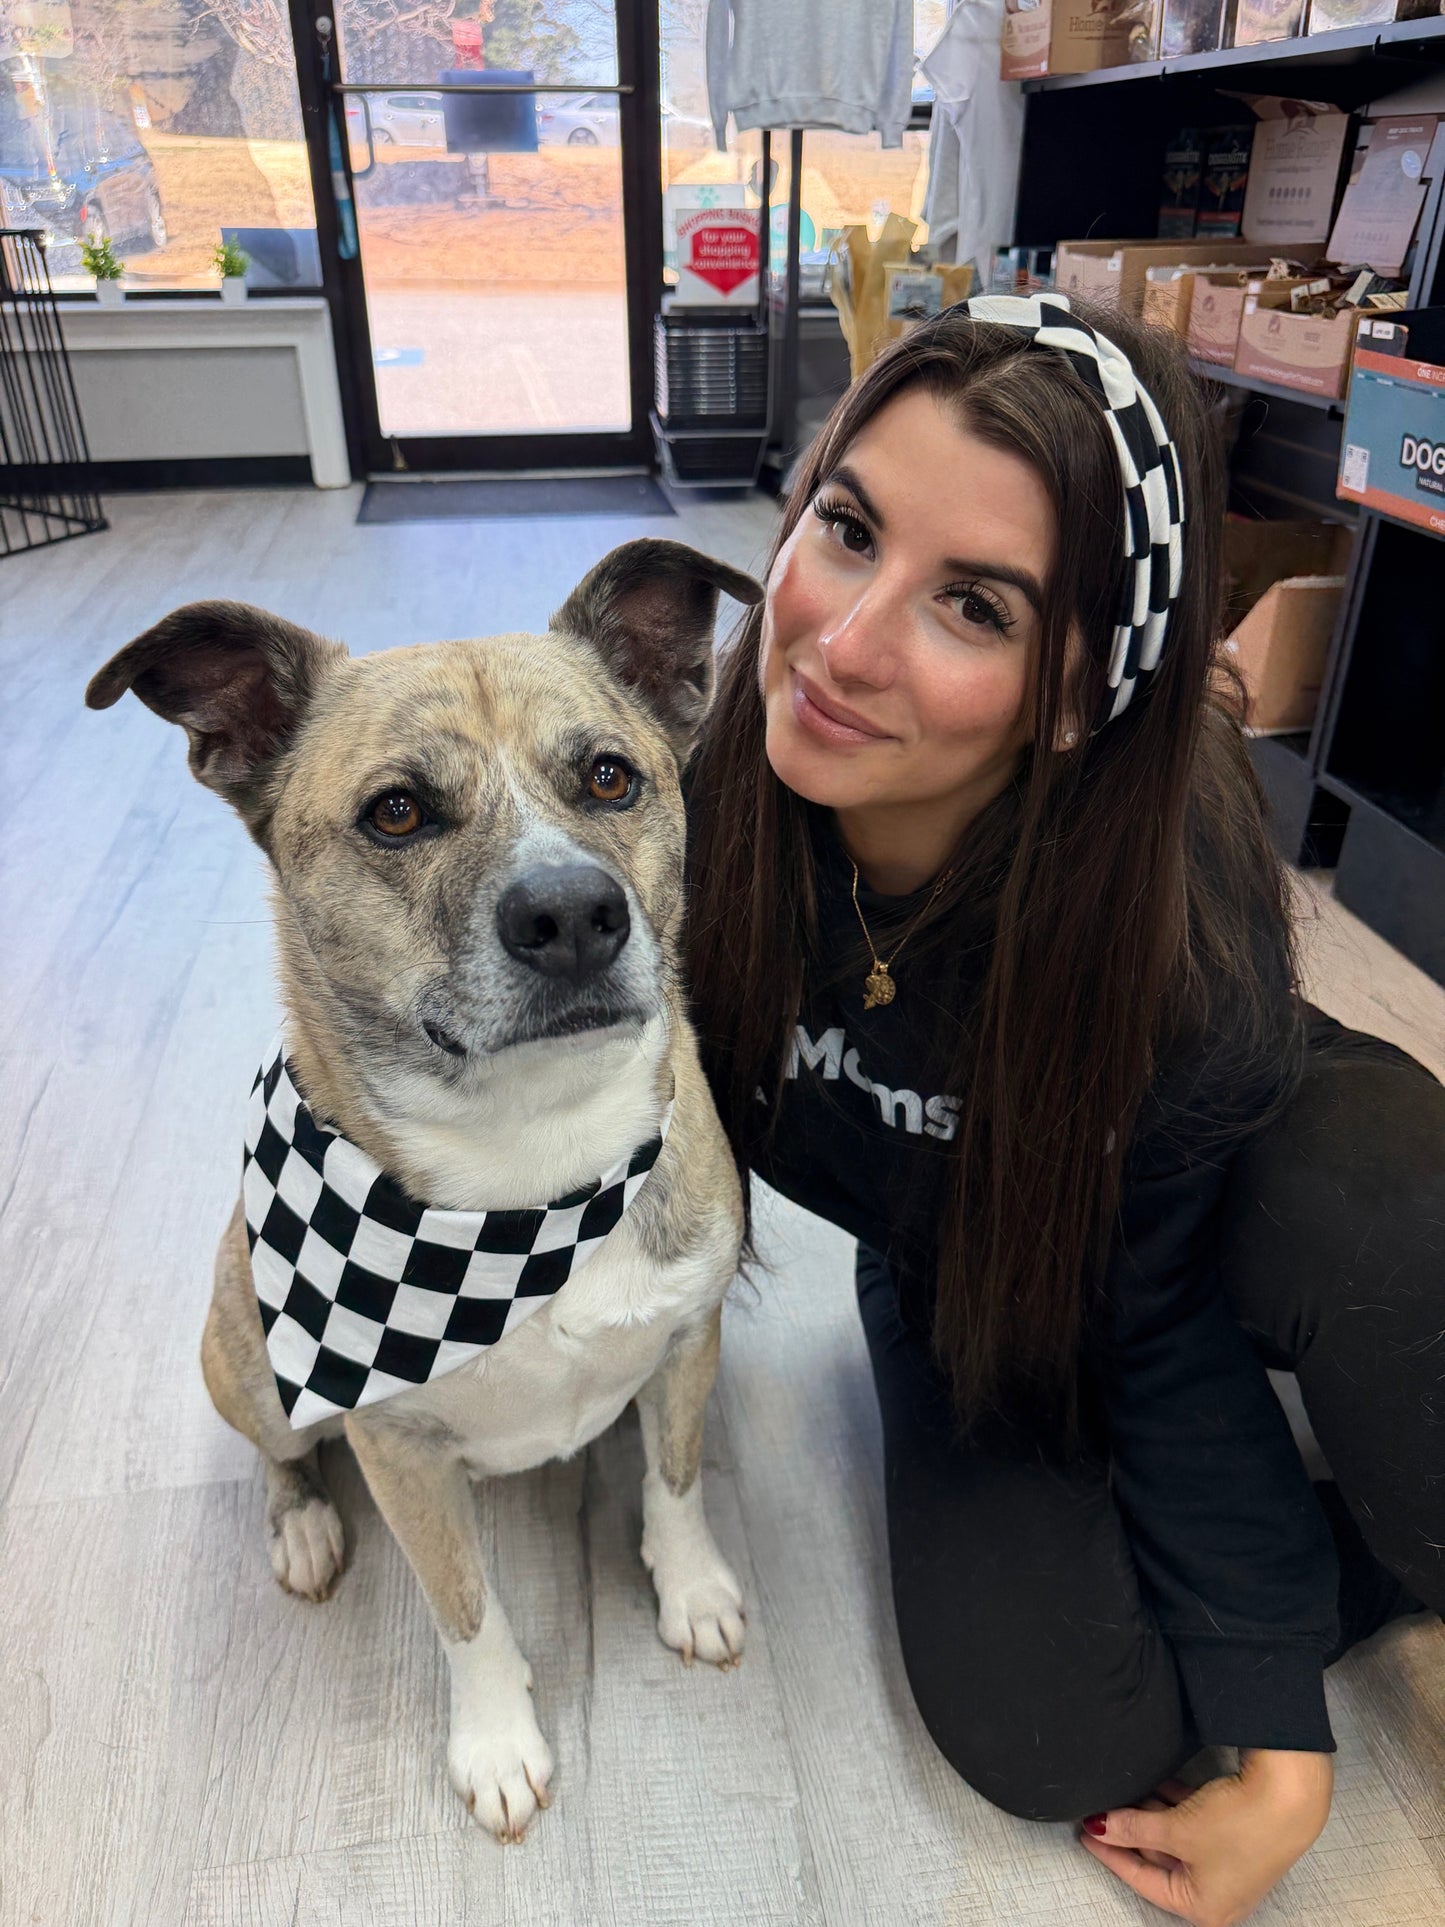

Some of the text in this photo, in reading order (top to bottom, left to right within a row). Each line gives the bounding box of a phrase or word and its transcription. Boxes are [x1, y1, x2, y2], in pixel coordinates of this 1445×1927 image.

[701, 230, 747, 247] for your
[698, 244, 751, 258] shopping
